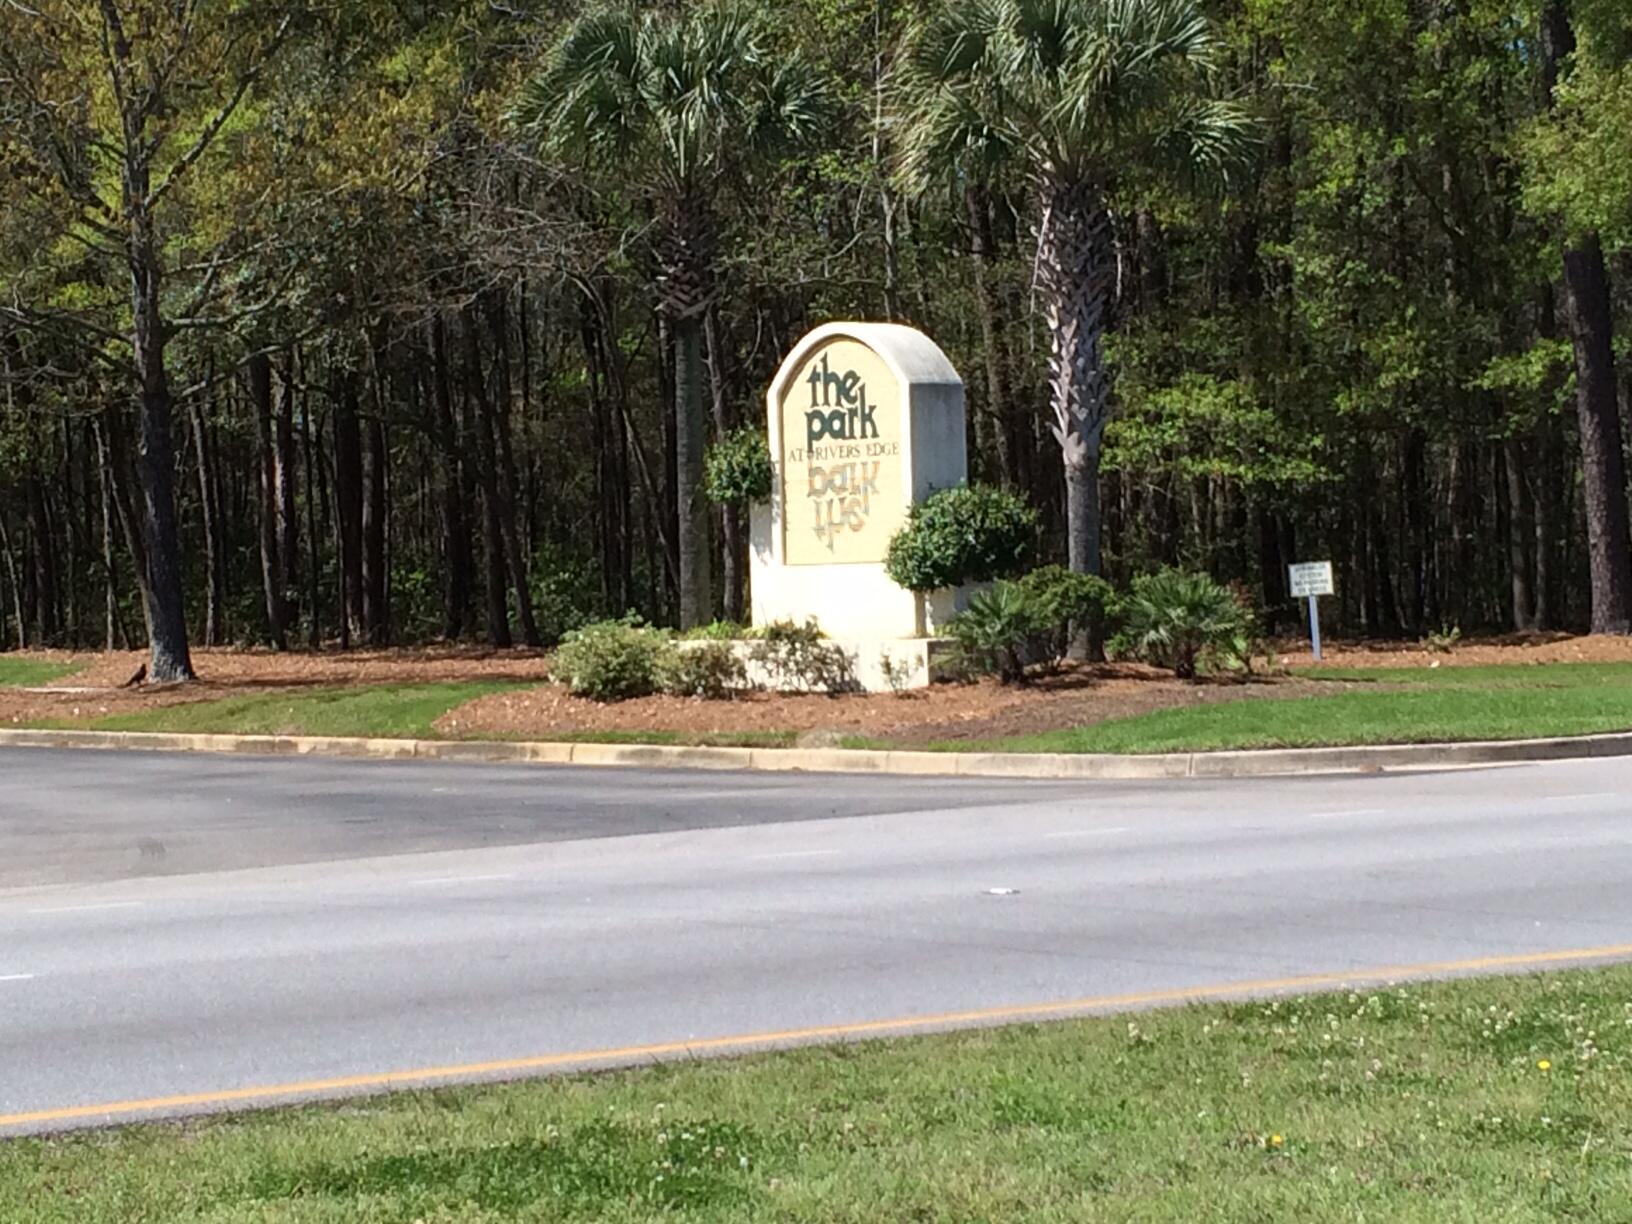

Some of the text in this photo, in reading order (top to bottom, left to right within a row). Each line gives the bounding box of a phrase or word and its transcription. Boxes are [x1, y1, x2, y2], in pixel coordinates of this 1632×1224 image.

[807, 351, 862, 408] the
[804, 383, 880, 454] park
[788, 442, 900, 463] AT RIVERS EDGE
